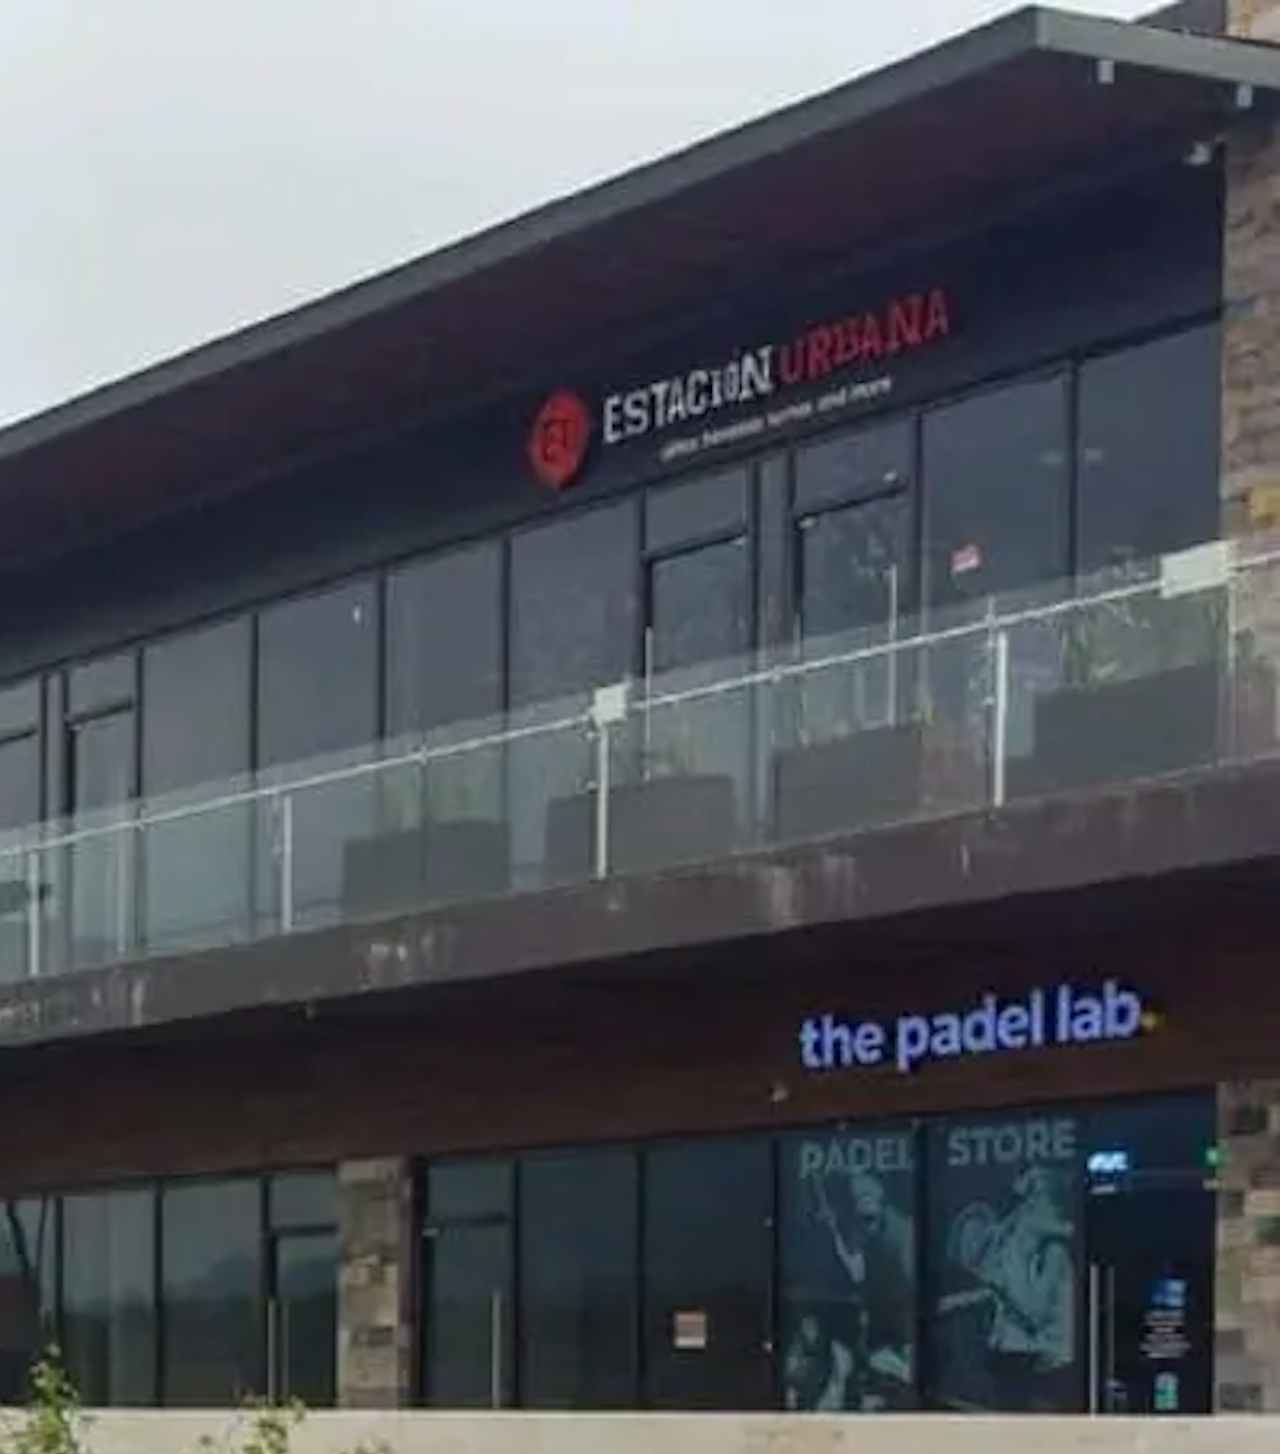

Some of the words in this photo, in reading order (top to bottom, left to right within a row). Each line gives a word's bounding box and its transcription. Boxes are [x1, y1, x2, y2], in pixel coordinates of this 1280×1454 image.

[778, 288, 950, 385] URBANA
[800, 1014, 886, 1068] the
[895, 988, 1043, 1073] padel
[799, 1136, 916, 1180] PADEL
[947, 1118, 1078, 1168] STORE
